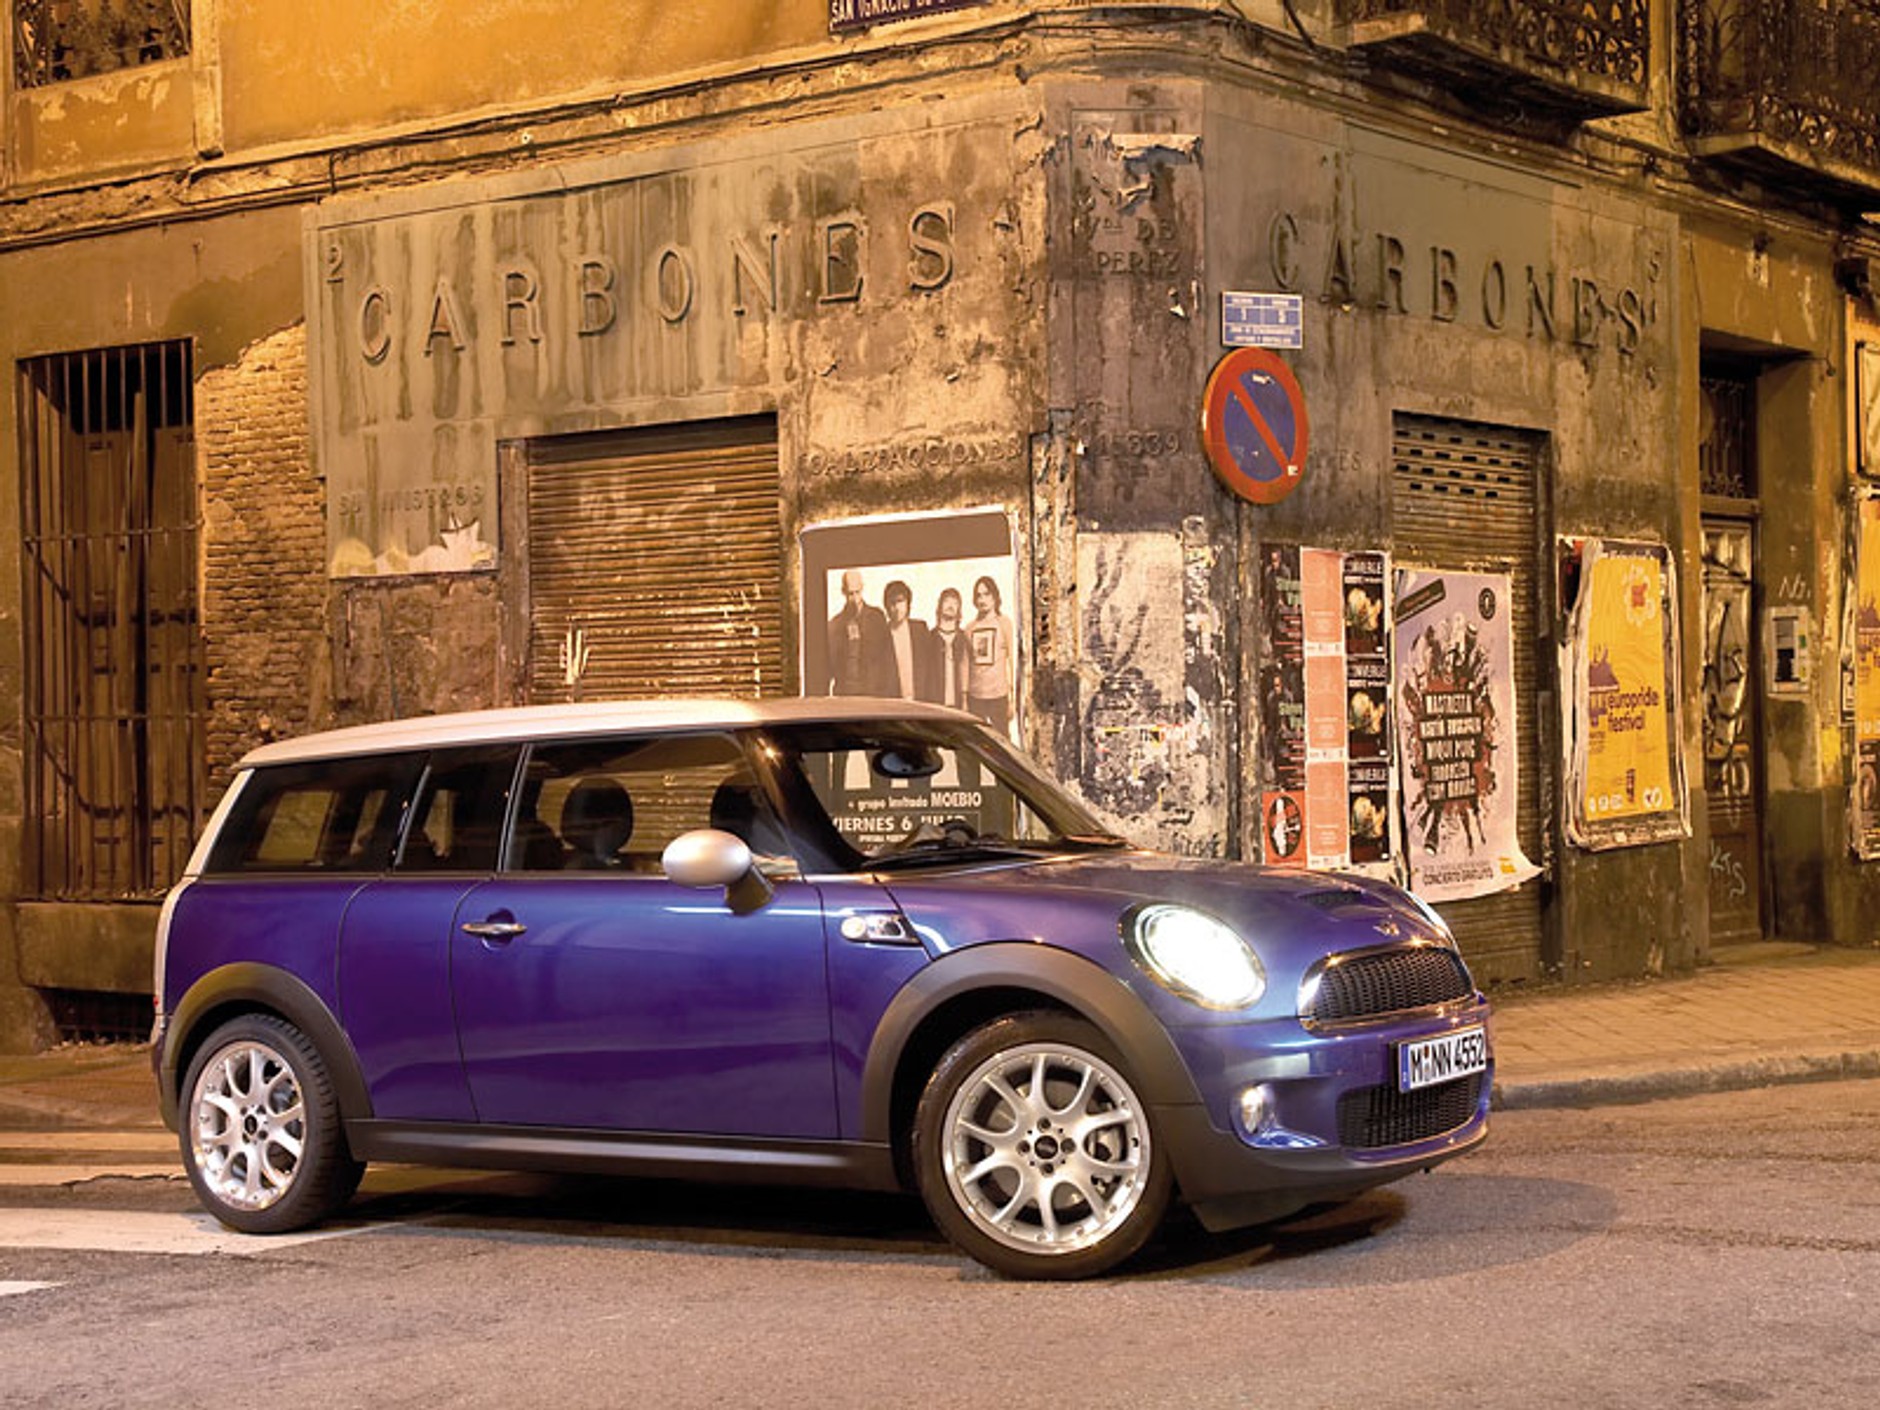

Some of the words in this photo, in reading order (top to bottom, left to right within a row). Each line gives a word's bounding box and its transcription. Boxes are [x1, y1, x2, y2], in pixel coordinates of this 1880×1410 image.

[831, 0, 855, 23] SAN
[361, 201, 955, 367] CARBONES
[1268, 210, 1642, 356] CARBONES
[930, 792, 982, 808] MOEBIO
[832, 817, 895, 832] VIERNES
[901, 817, 913, 832] 6
[1454, 1033, 1485, 1071] 4552
